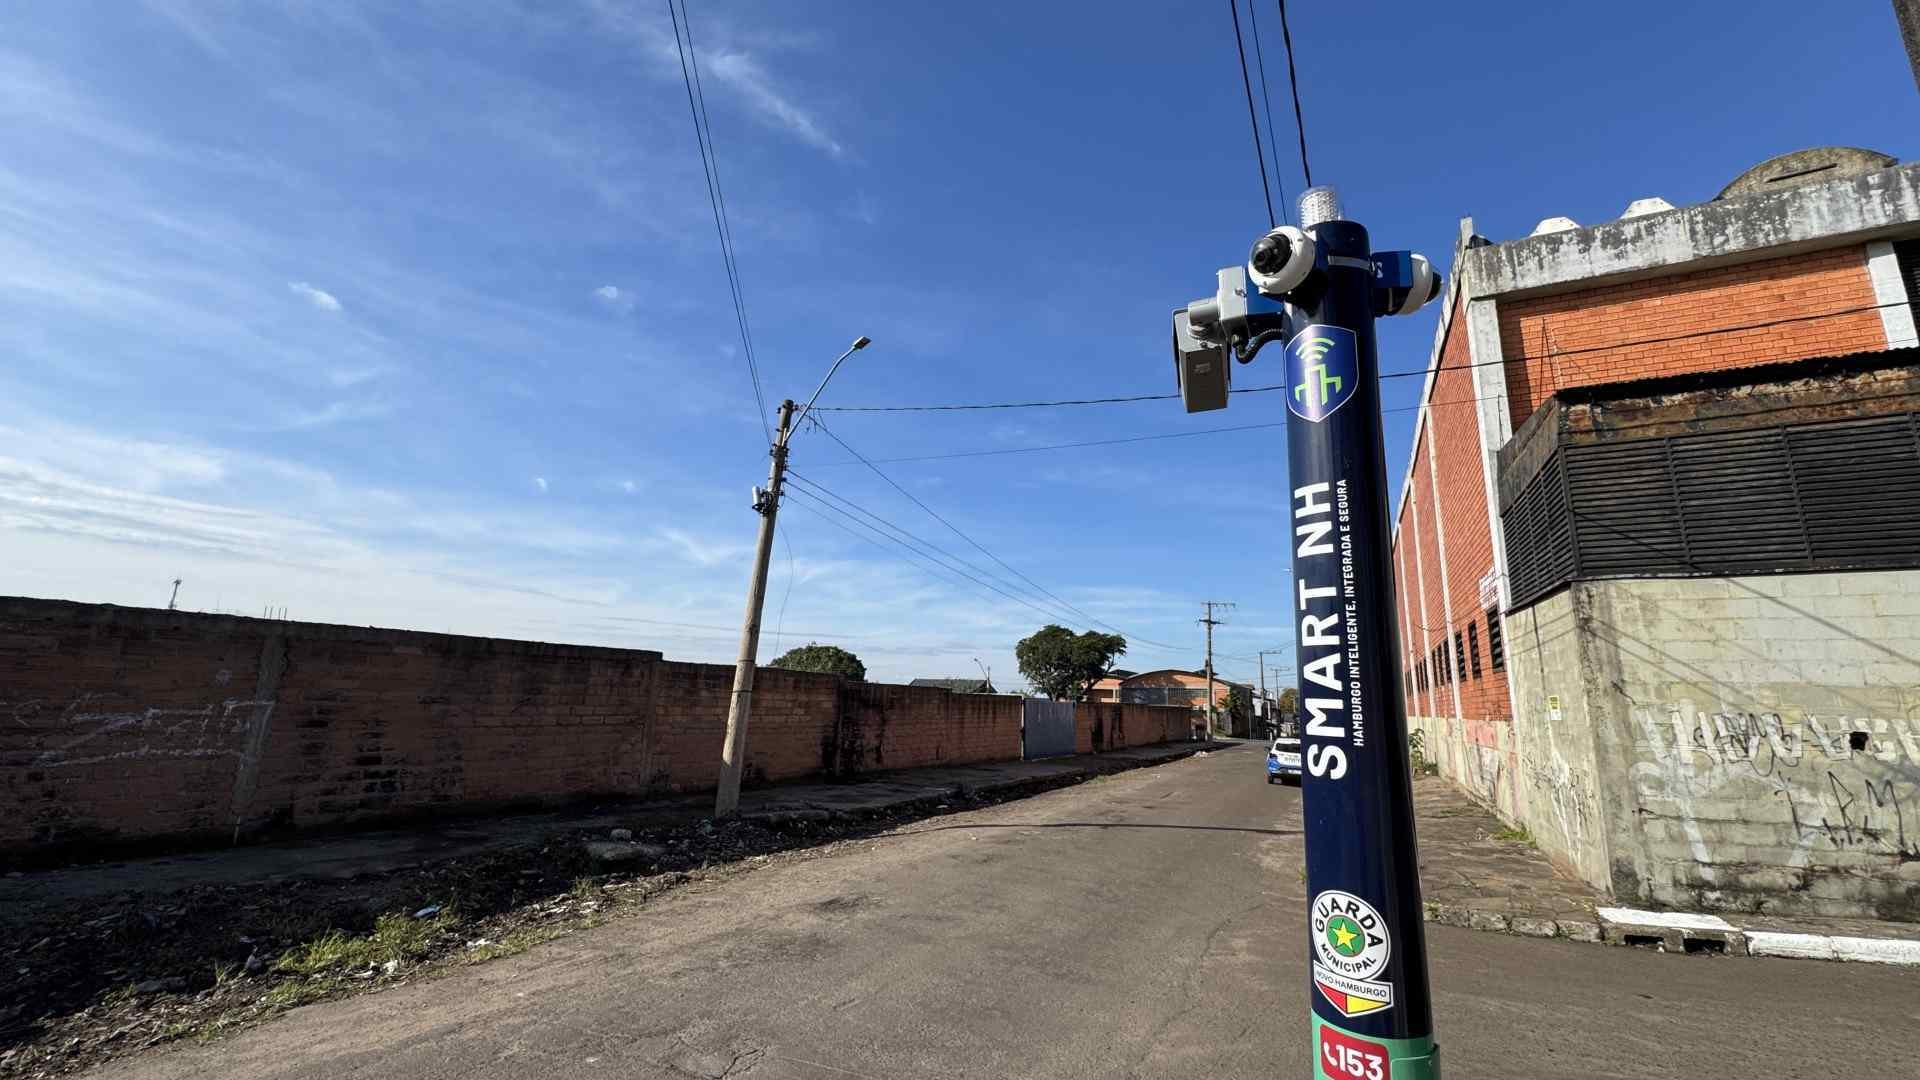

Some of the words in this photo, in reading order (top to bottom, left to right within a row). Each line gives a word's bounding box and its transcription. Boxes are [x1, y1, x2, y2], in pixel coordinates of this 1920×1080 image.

[1295, 481, 1334, 558] NH
[1337, 479, 1349, 522] SEGURA
[1340, 524, 1350, 532] E
[1342, 534, 1355, 597] INTEGRADA
[1346, 601, 1360, 678] INTELIGENTE,
[1299, 579, 1348, 780] SMART
[1351, 681, 1364, 746] HAMBURGO
[1315, 897, 1384, 948] GUARDA
[1321, 943, 1377, 973] MUNICIPAL
[1334, 979, 1387, 998] HAMBURGO
[1335, 1043, 1384, 1080] 153
